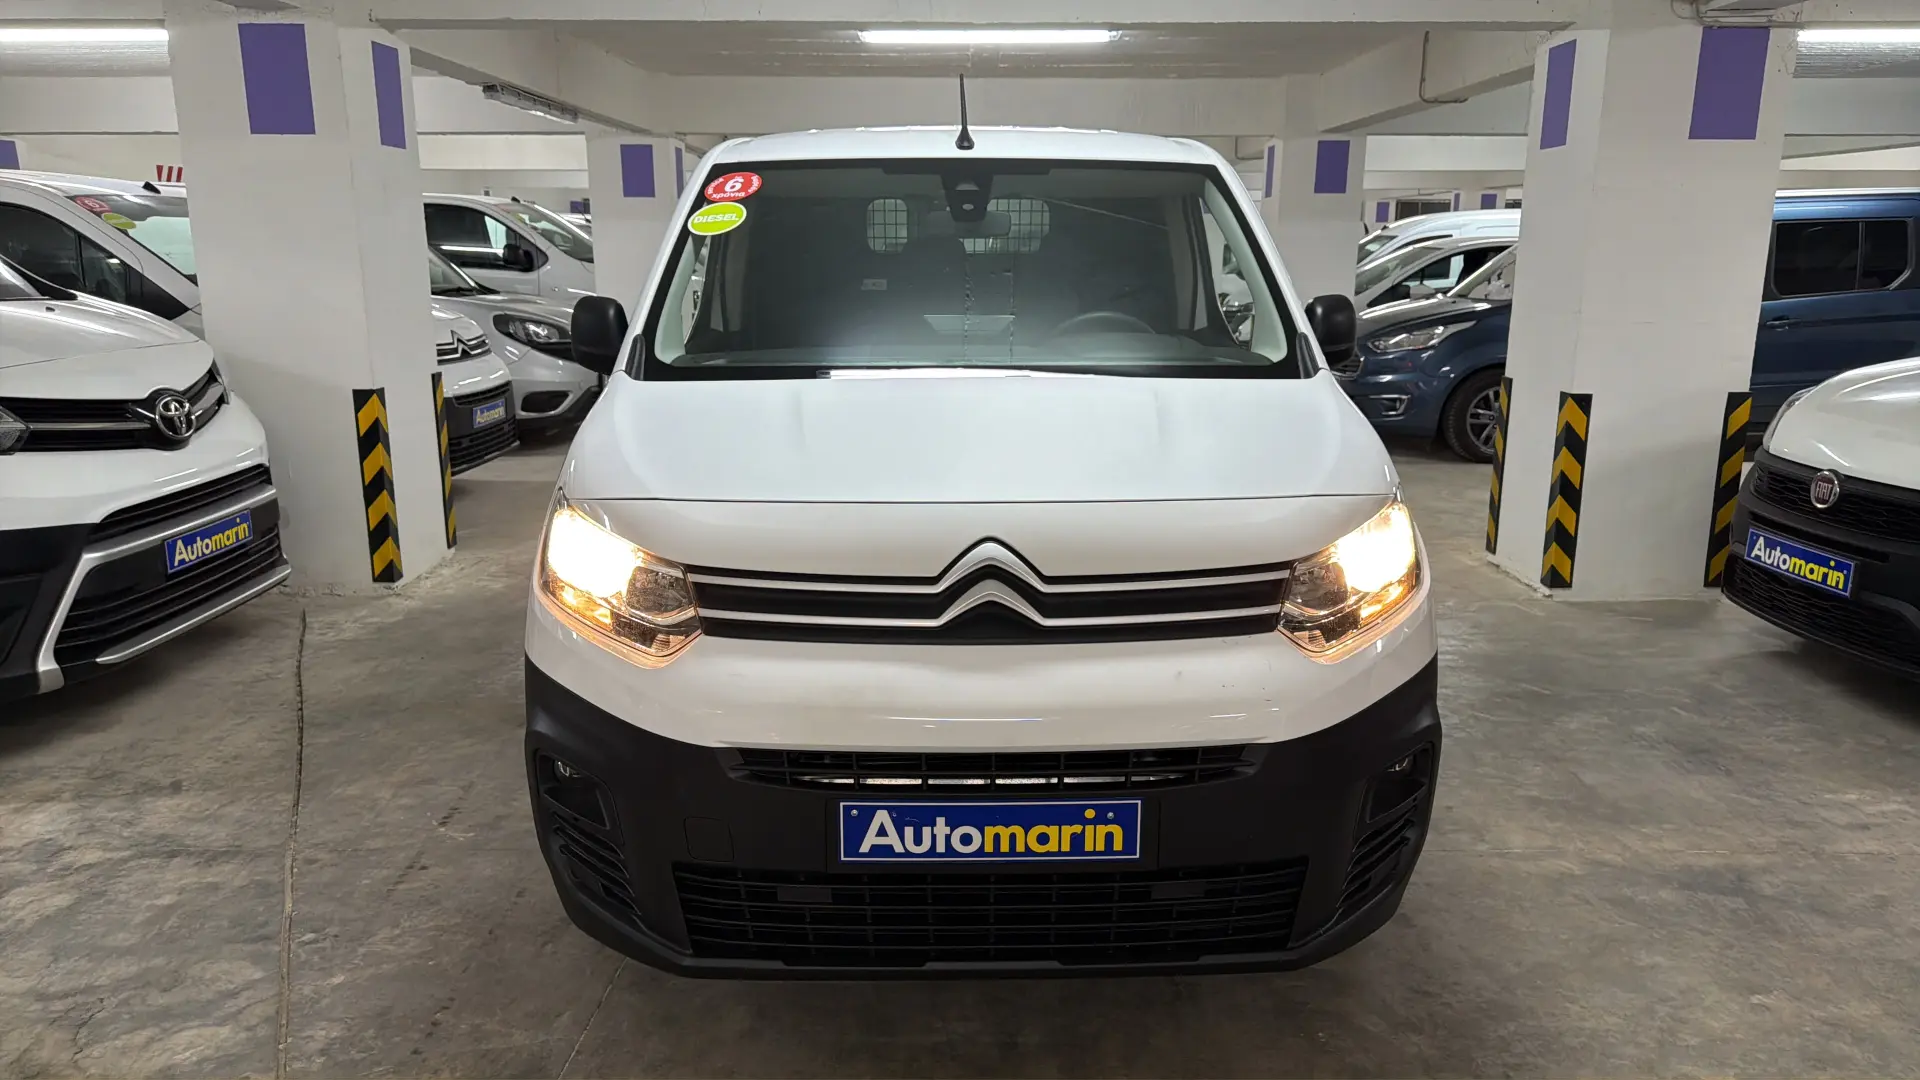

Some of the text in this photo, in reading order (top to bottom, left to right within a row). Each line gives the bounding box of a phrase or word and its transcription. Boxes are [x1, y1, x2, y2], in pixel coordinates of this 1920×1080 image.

[724, 178, 744, 193] 6
[693, 213, 739, 224] DIESEL
[1815, 481, 1832, 500] FIAT
[174, 517, 249, 567] Automarin
[1751, 535, 1845, 590] Automarin
[858, 808, 1123, 853] Automarin
